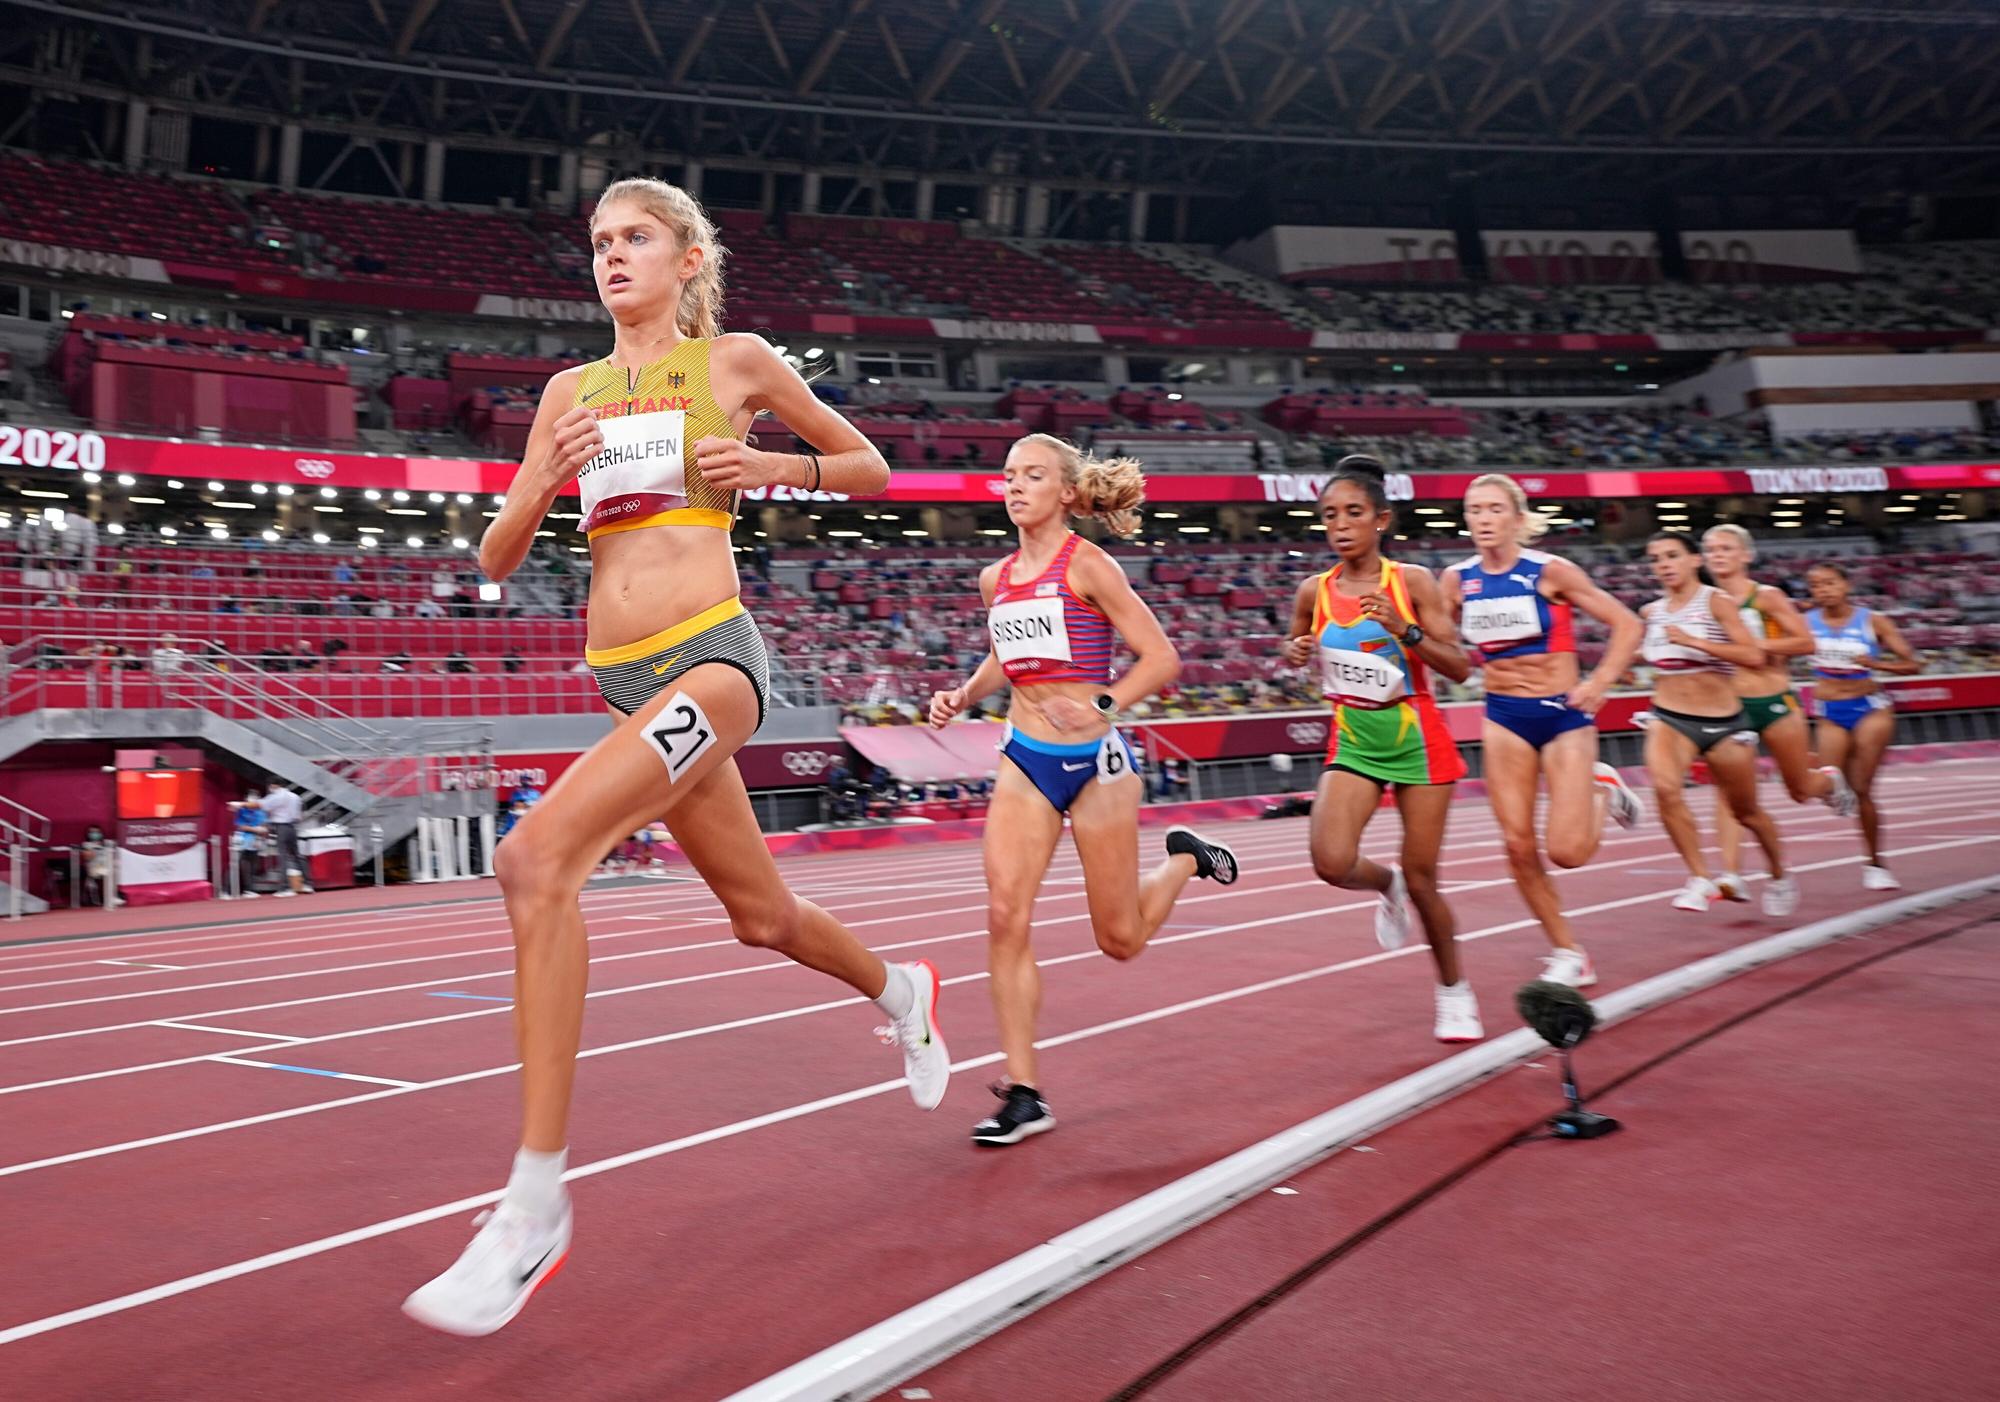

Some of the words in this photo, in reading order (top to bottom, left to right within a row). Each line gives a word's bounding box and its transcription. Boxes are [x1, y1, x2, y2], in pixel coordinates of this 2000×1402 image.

[594, 395, 693, 420] RMANY
[0, 425, 106, 471] 2020
[578, 437, 677, 478] OSTERHALFEN
[993, 615, 1053, 643] SISSON
[1329, 661, 1388, 688] TESFU
[652, 705, 709, 772] 21
